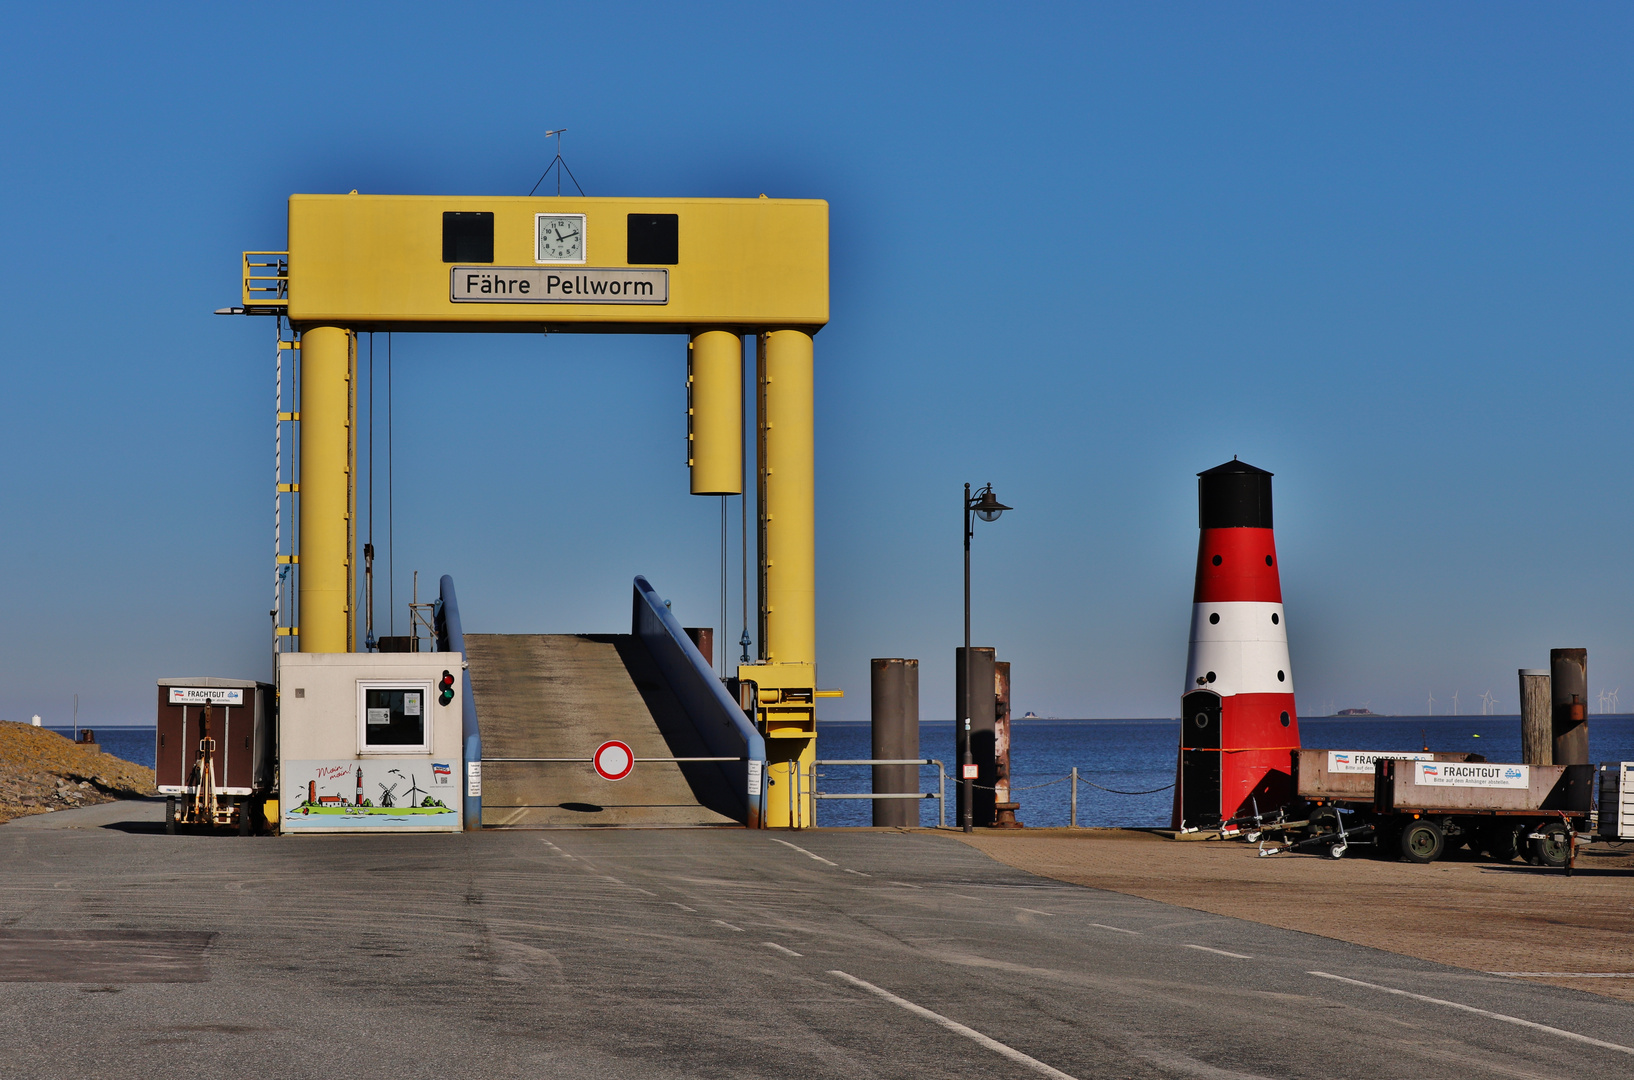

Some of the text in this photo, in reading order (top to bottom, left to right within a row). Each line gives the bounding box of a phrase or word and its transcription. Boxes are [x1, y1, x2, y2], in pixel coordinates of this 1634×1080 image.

[466, 274, 654, 296] Fähre Pellworm
[1443, 766, 1500, 778] FRACHTGUT
